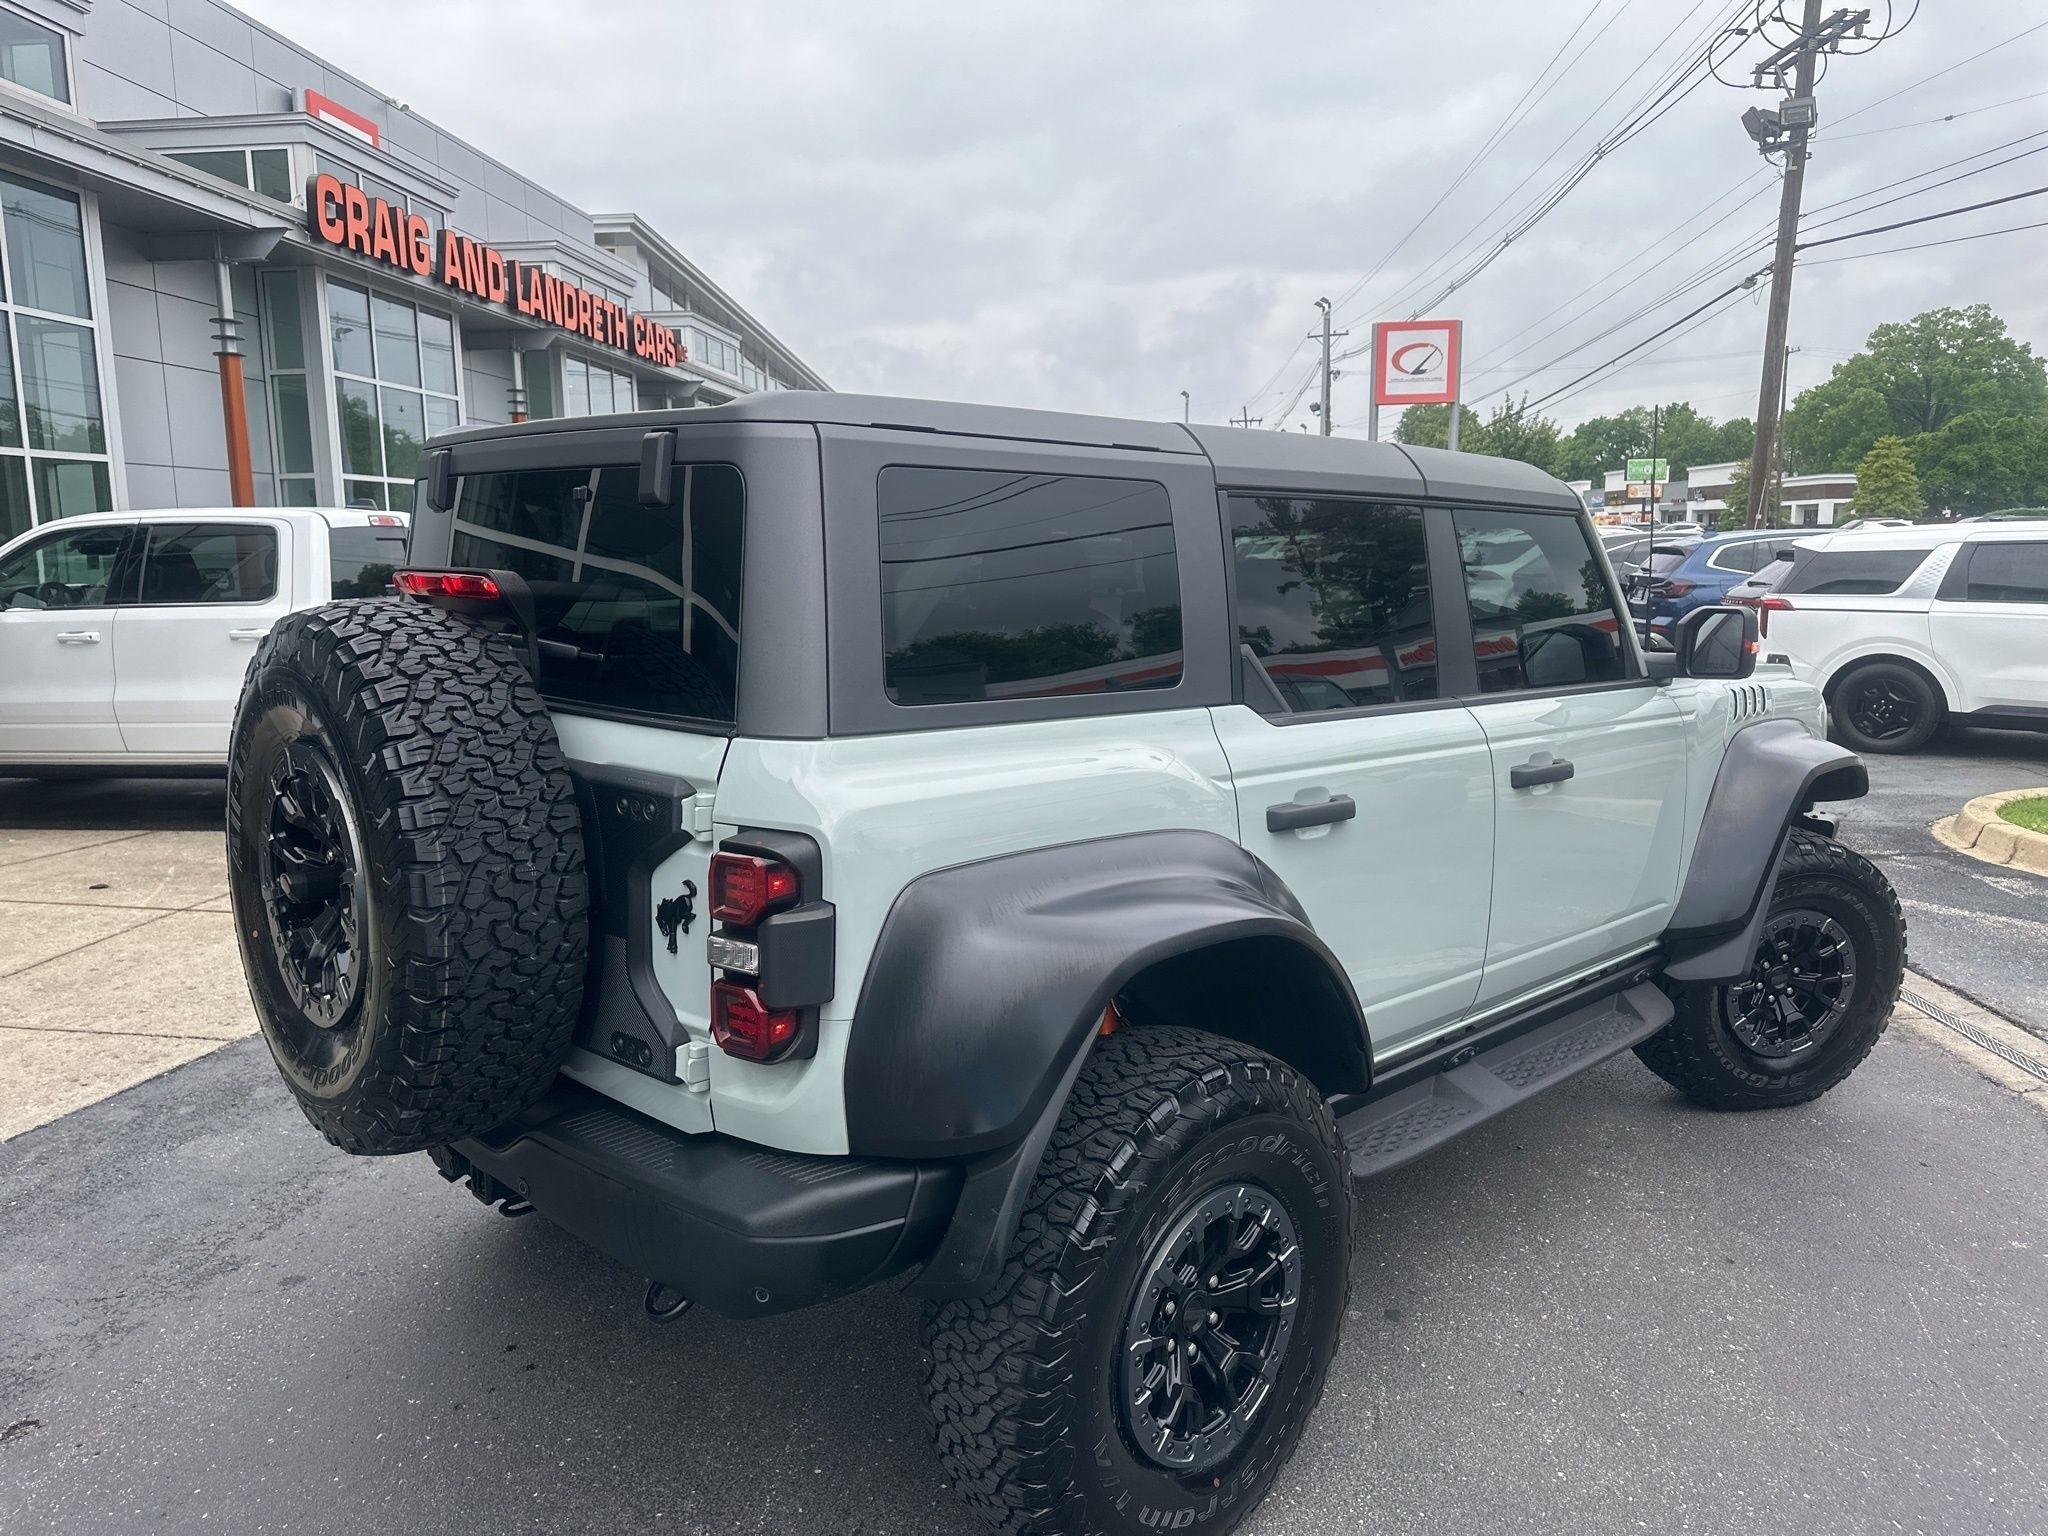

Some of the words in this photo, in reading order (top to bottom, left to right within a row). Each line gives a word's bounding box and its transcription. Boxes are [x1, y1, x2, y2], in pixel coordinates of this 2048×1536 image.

[311, 172, 431, 277] CRAIG
[440, 227, 505, 304] AND
[510, 259, 628, 351] LANDRETH
[632, 313, 677, 368] CARS
